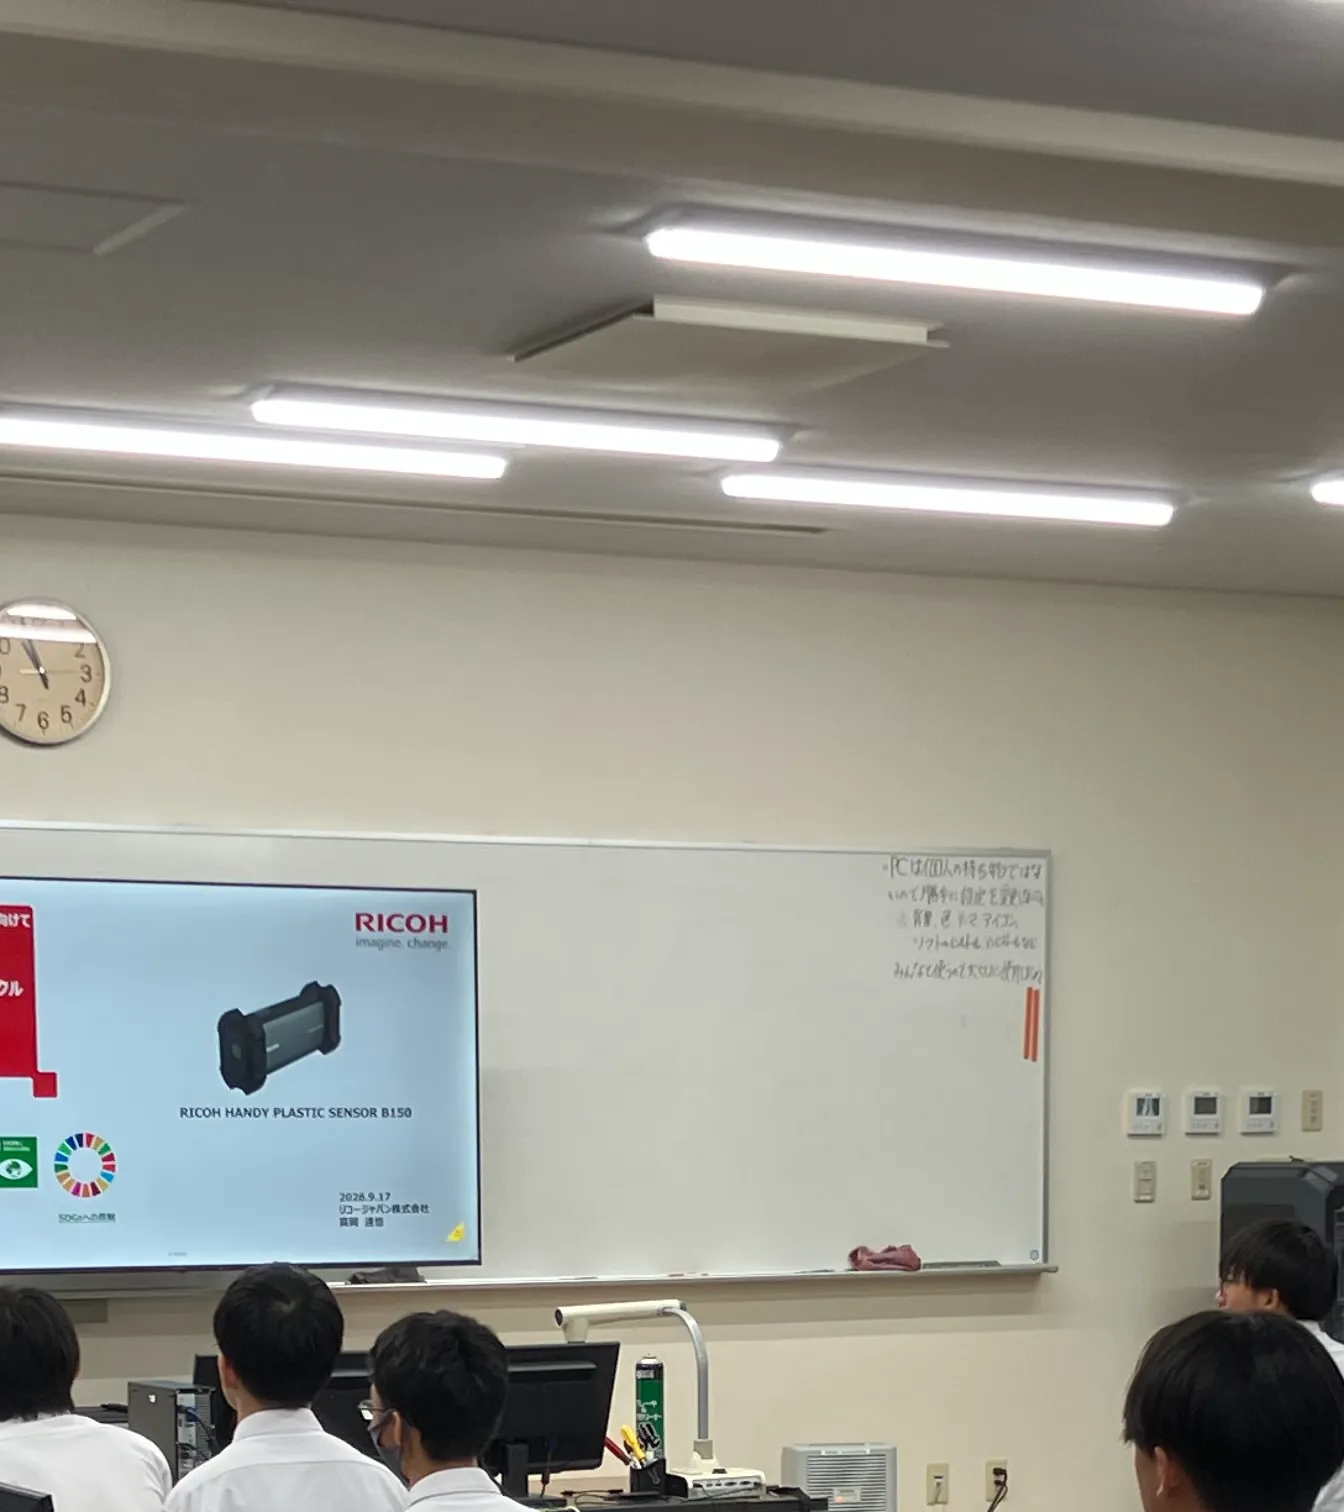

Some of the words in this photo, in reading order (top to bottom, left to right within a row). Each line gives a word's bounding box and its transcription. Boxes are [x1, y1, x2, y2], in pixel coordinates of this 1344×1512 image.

[80, 664, 93, 683] 3
[74, 688, 87, 707] 4
[16, 704, 27, 722] 7
[37, 711, 49, 730] 6
[60, 705, 73, 724] 5
[355, 912, 449, 934] RICOH
[355, 935, 404, 951] imagine.
[407, 936, 452, 952] change.
[179, 1106, 221, 1119] RICOH
[225, 1106, 270, 1119] HANDY
[273, 1106, 325, 1119] PLASTIC
[329, 1106, 377, 1119] SENSOR
[381, 1106, 413, 1119] B150
[339, 1203, 430, 1215] リコージャパン株式会社
